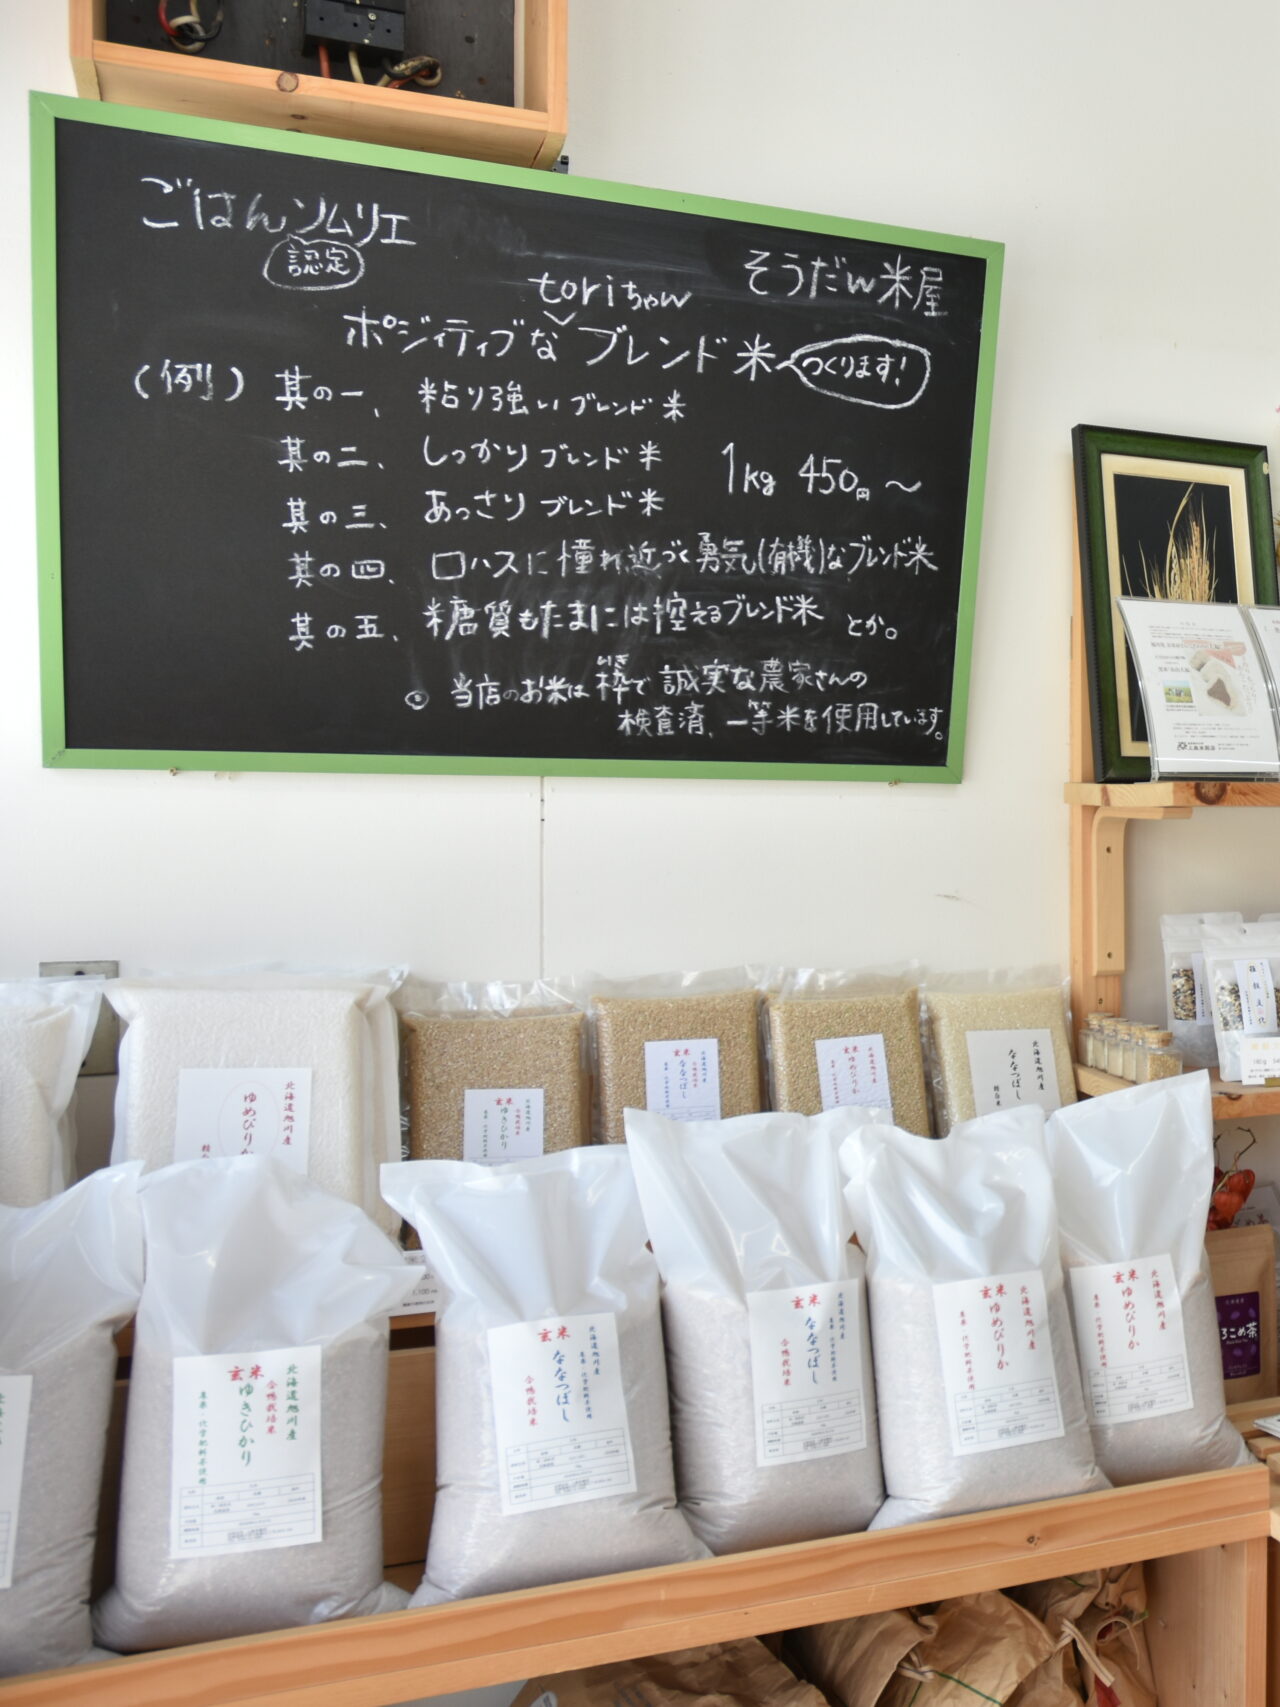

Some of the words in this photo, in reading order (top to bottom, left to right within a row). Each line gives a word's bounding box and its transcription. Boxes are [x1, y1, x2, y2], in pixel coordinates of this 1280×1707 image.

[288, 247, 350, 276] 認定
[537, 1325, 571, 1343] 玄米
[1221, 1321, 1258, 1340] ろこめ茶
[228, 1364, 264, 1382] 玄米
[552, 1349, 570, 1423] ななつぼし
